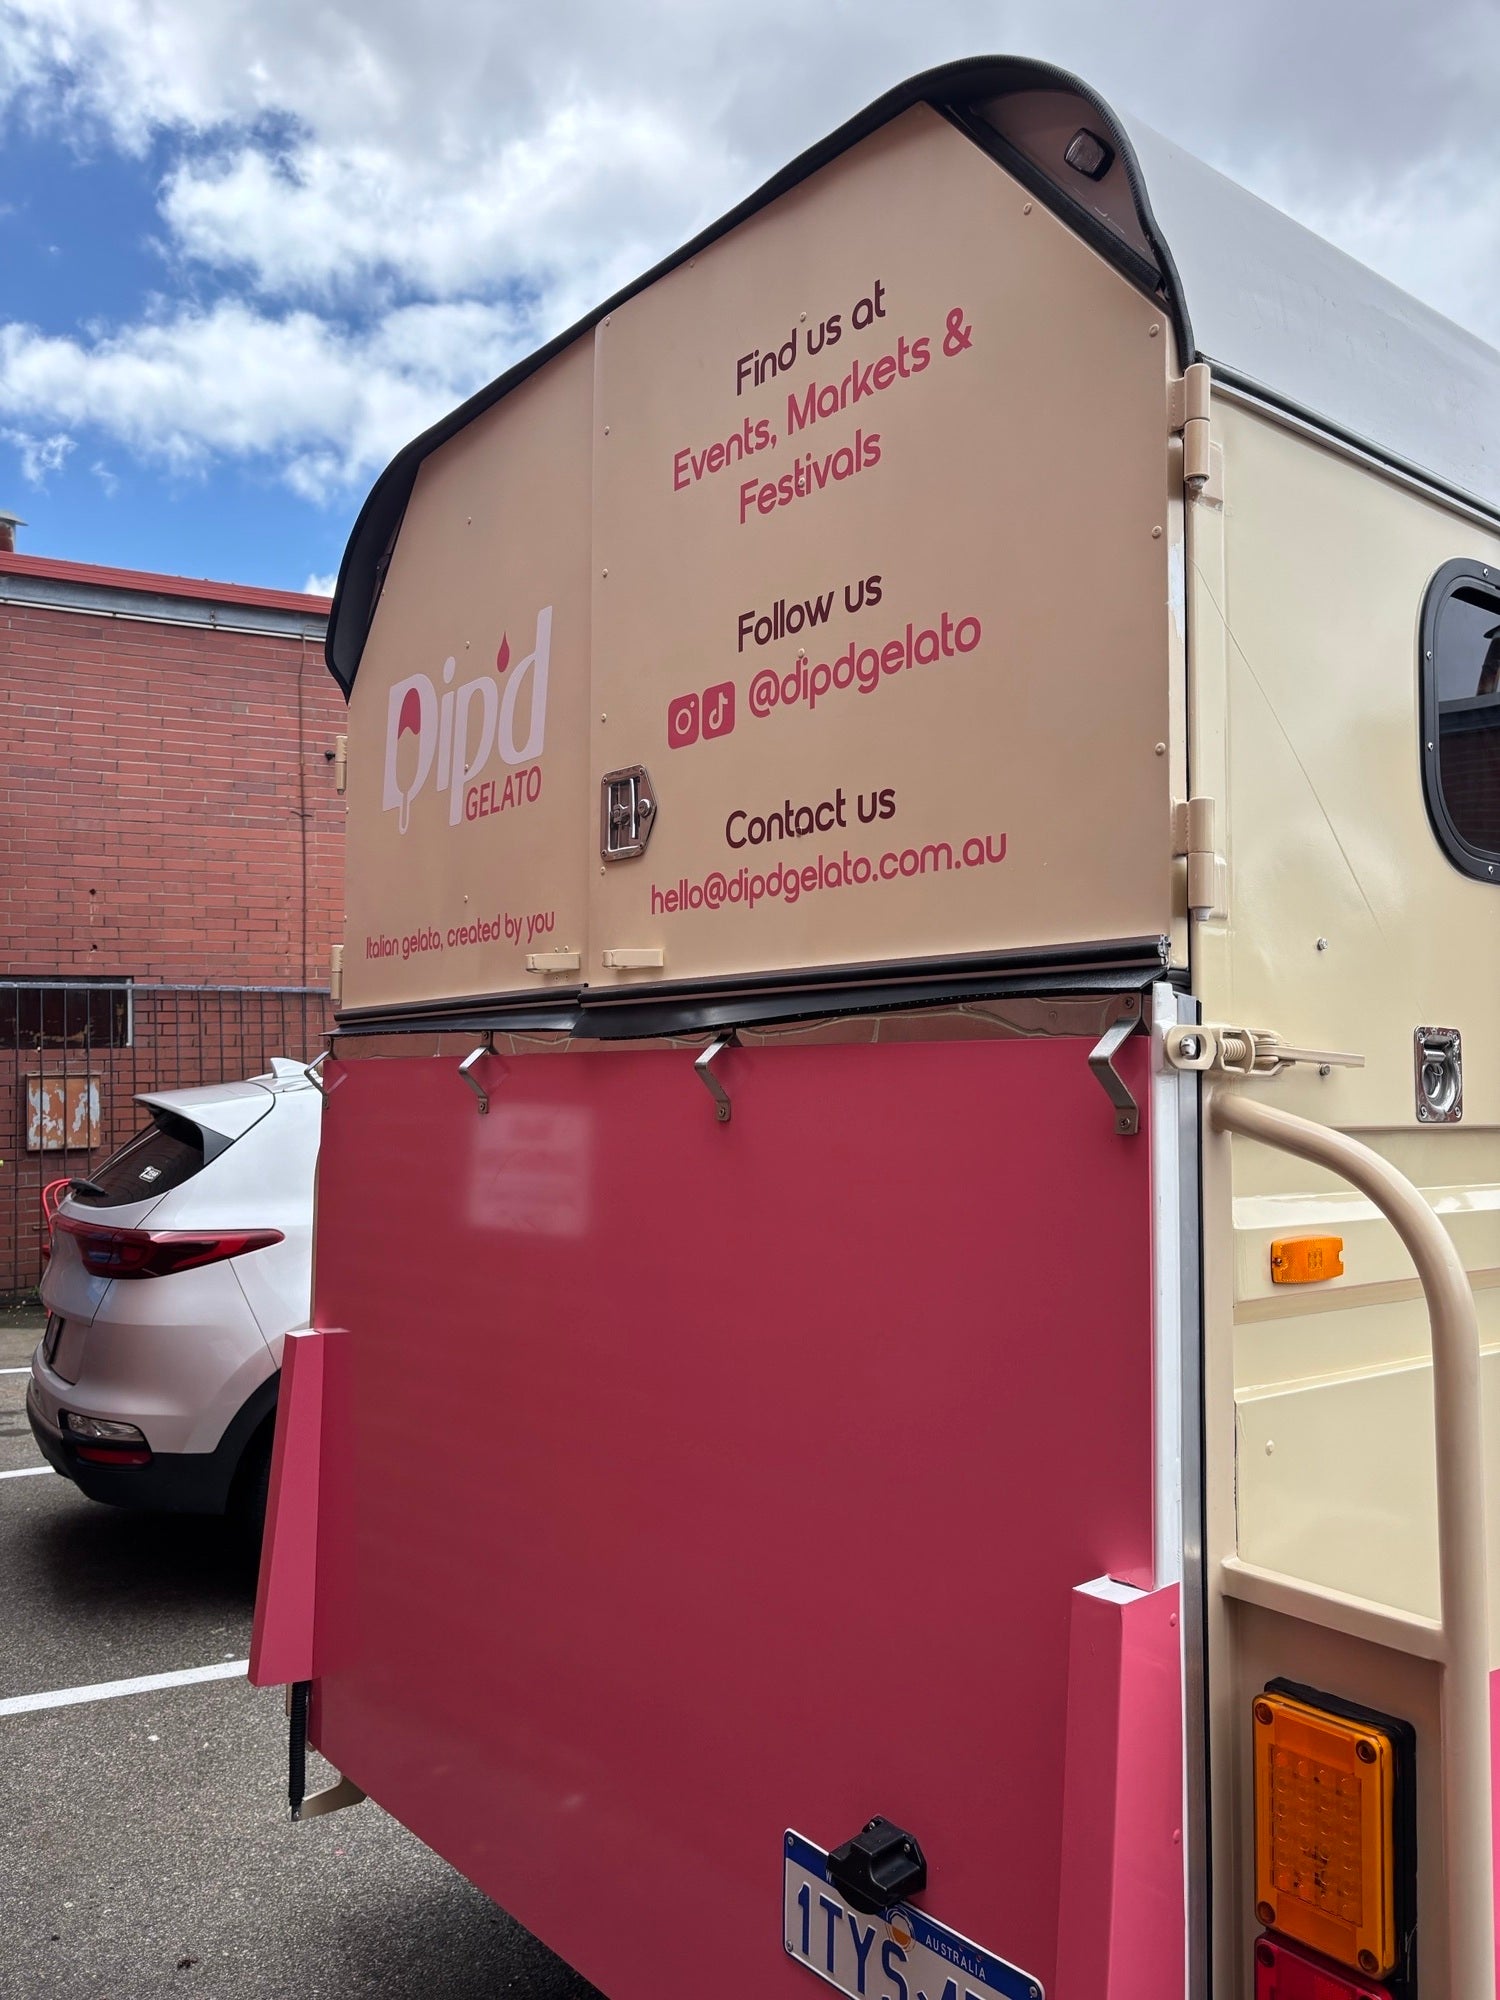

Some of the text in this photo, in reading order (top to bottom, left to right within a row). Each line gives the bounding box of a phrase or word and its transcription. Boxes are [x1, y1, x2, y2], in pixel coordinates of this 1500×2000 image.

[737, 279, 886, 396] Find us at
[674, 307, 973, 491] Events, Markets &
[740, 429, 881, 524] Festivals
[738, 575, 882, 653] Follow us
[749, 612, 981, 718] @dipdgelato
[466, 766, 541, 820] GELATO
[726, 788, 895, 849] Contact us
[652, 833, 1007, 914] hello@dipdgelato.com.au
[366, 912, 554, 960] Italian gelato, created by you
[797, 1882, 990, 2000] 1TYS
[926, 1935, 986, 1980] AUSTRALIA
